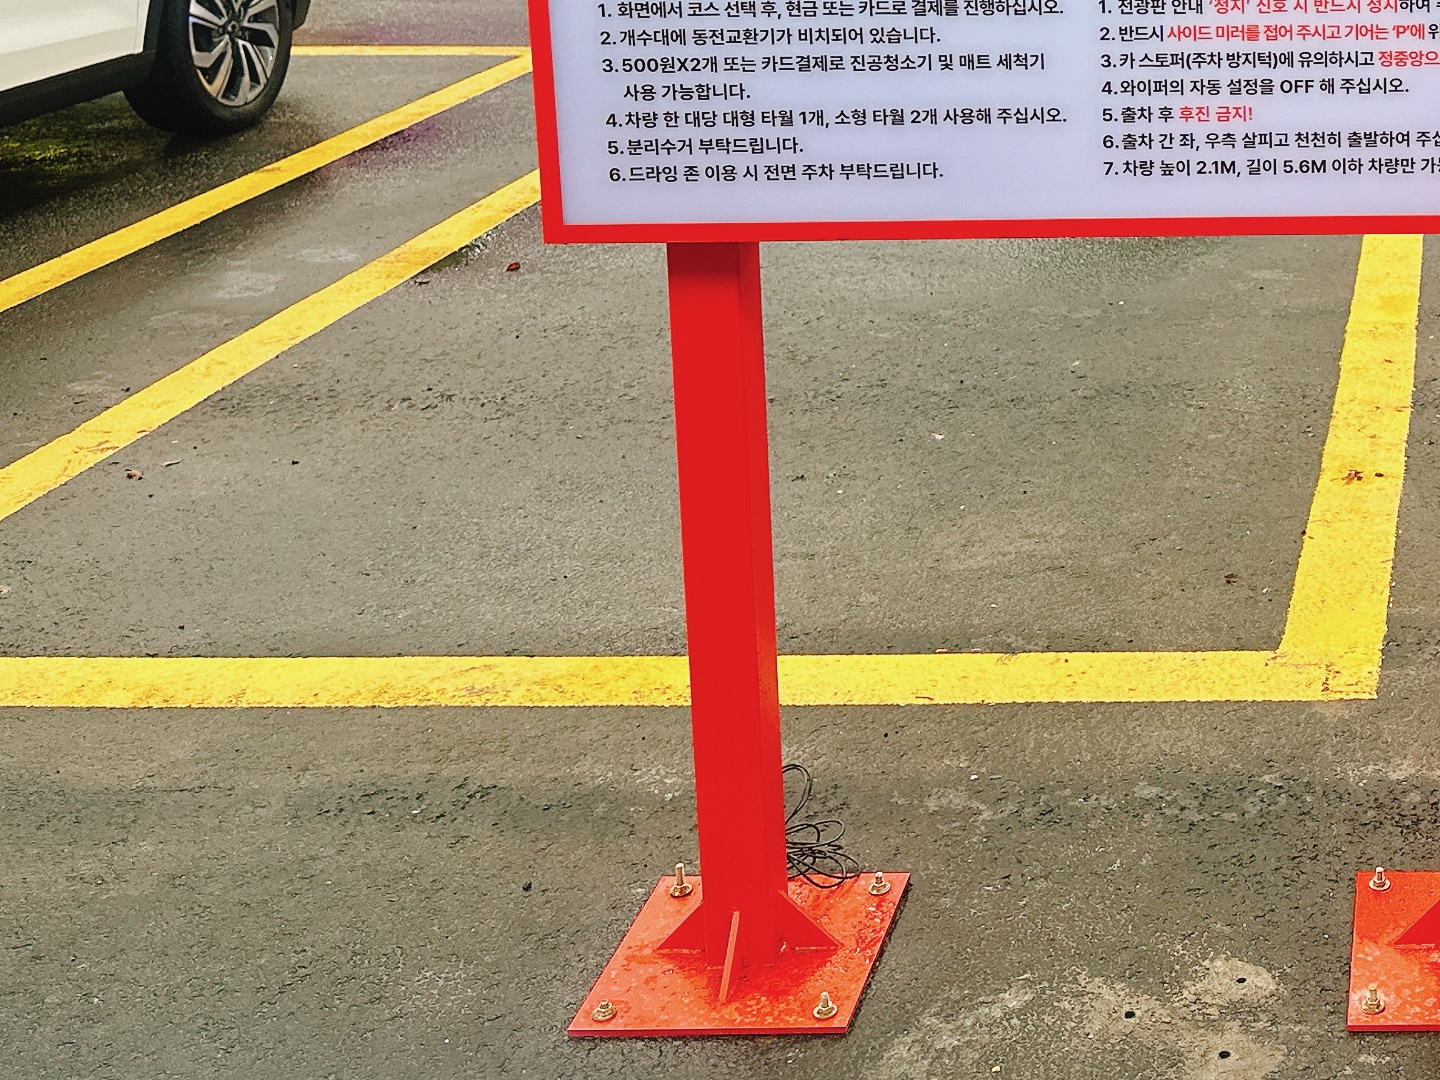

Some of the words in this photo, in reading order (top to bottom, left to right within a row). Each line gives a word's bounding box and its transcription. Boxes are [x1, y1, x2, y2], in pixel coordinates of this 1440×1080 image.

[620, 28, 686, 46] 개수대에
[692, 28, 792, 45] 동전교환기가
[798, 27, 863, 45] 비치되어
[870, 27, 940, 43] 있습니다.
[1120, 106, 1153, 123] 출차
[1158, 106, 1174, 123] 후
[1180, 106, 1209, 122] 후진
[1216, 106, 1252, 121] 금지!
[626, 138, 692, 155] 분리수거
[699, 137, 803, 154] 부탁드립니다.
